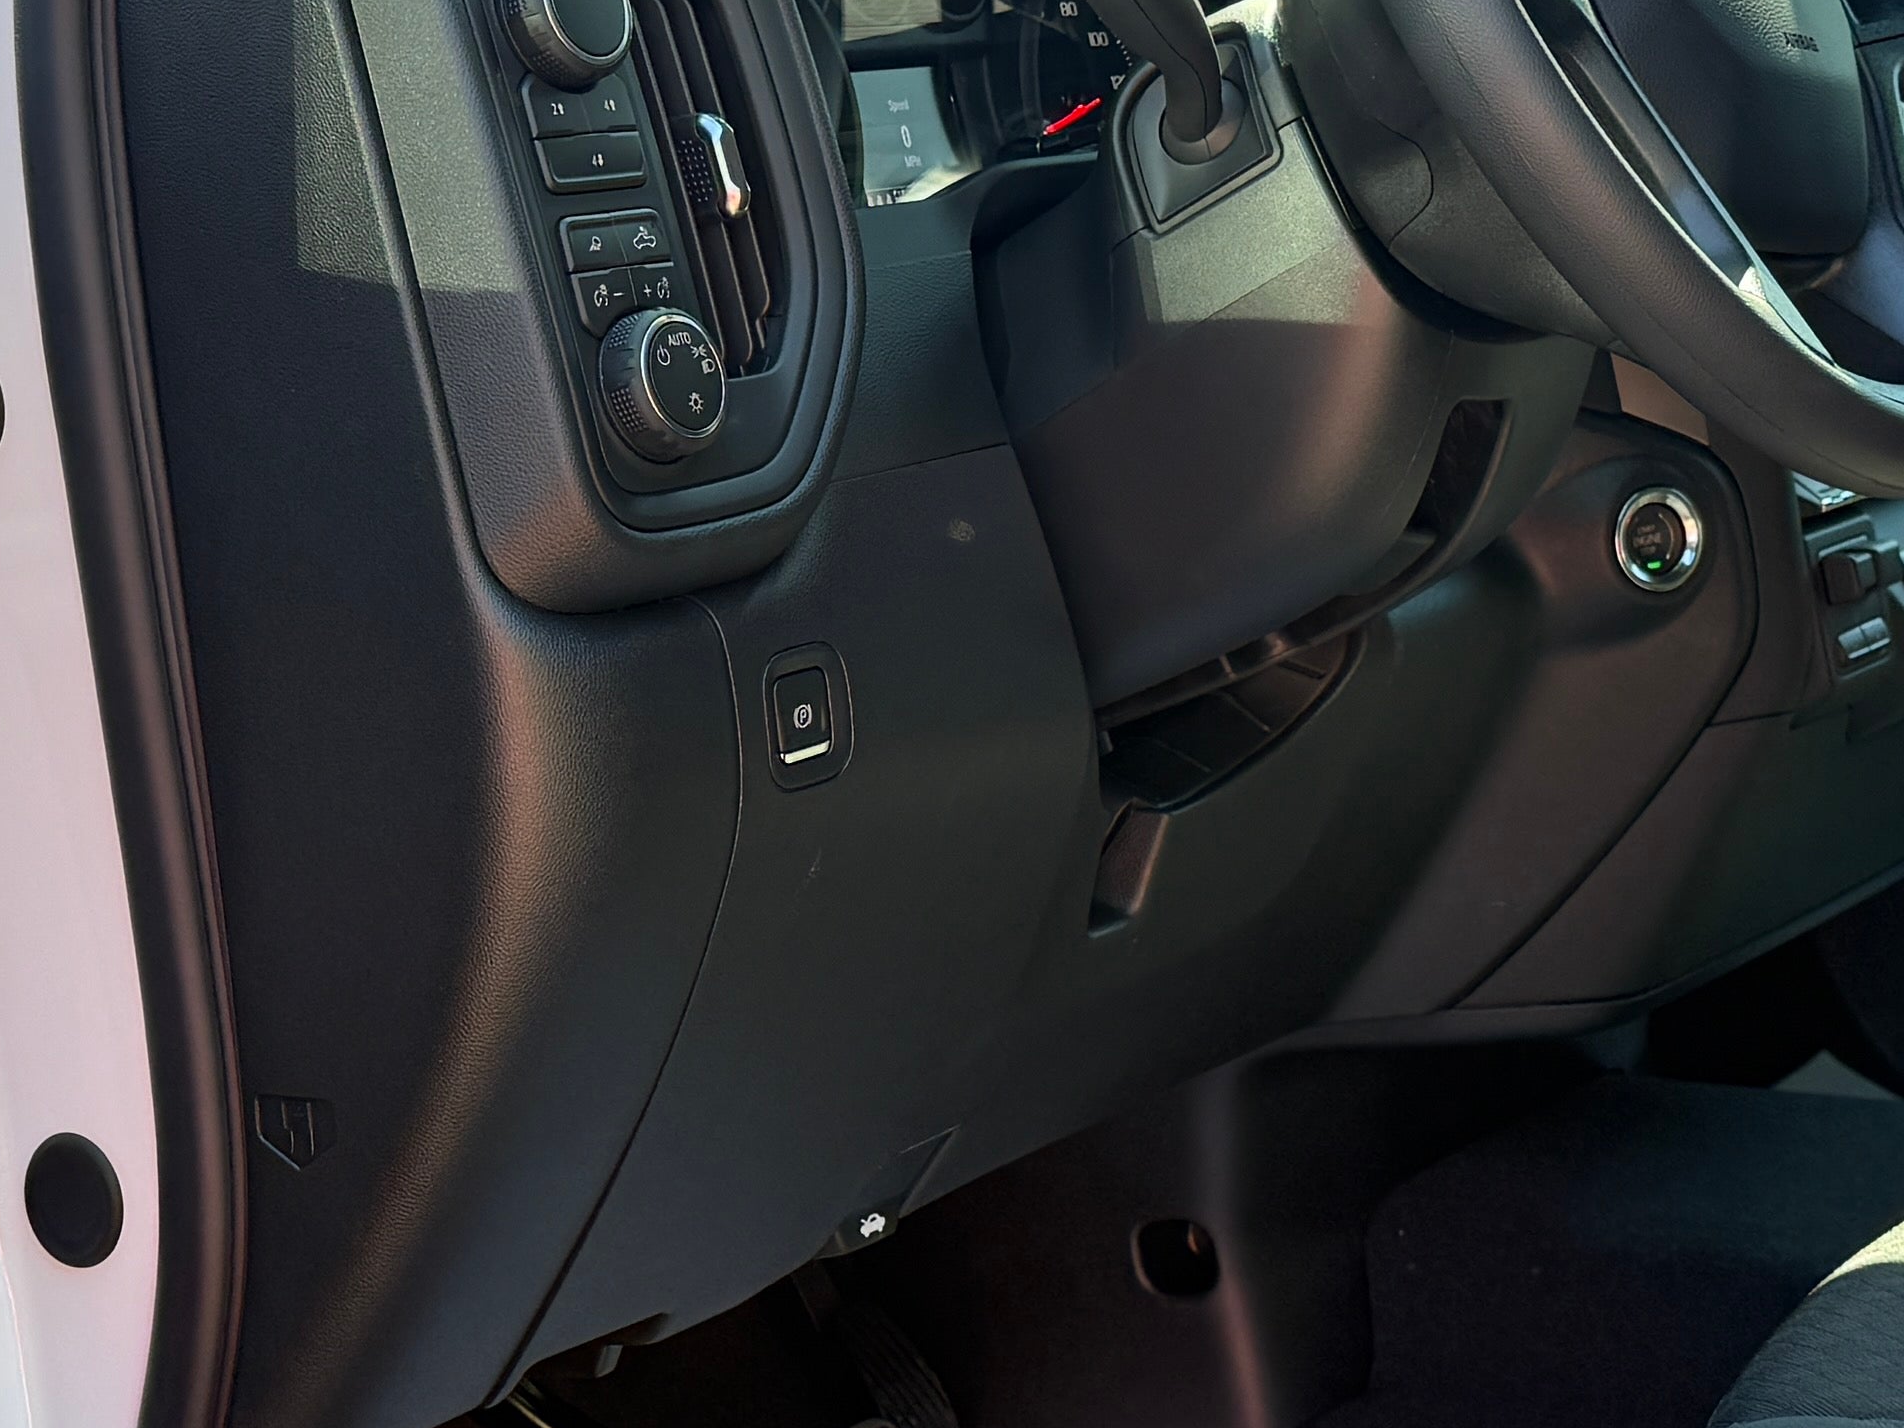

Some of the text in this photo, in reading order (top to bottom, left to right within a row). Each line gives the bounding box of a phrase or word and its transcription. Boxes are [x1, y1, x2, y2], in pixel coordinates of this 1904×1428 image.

[1059, 1, 1078, 16] 80
[1087, 32, 1110, 47] 100
[1782, 32, 1820, 52] AIRBAG
[900, 125, 912, 148] 0
[668, 331, 691, 347] AUTO
